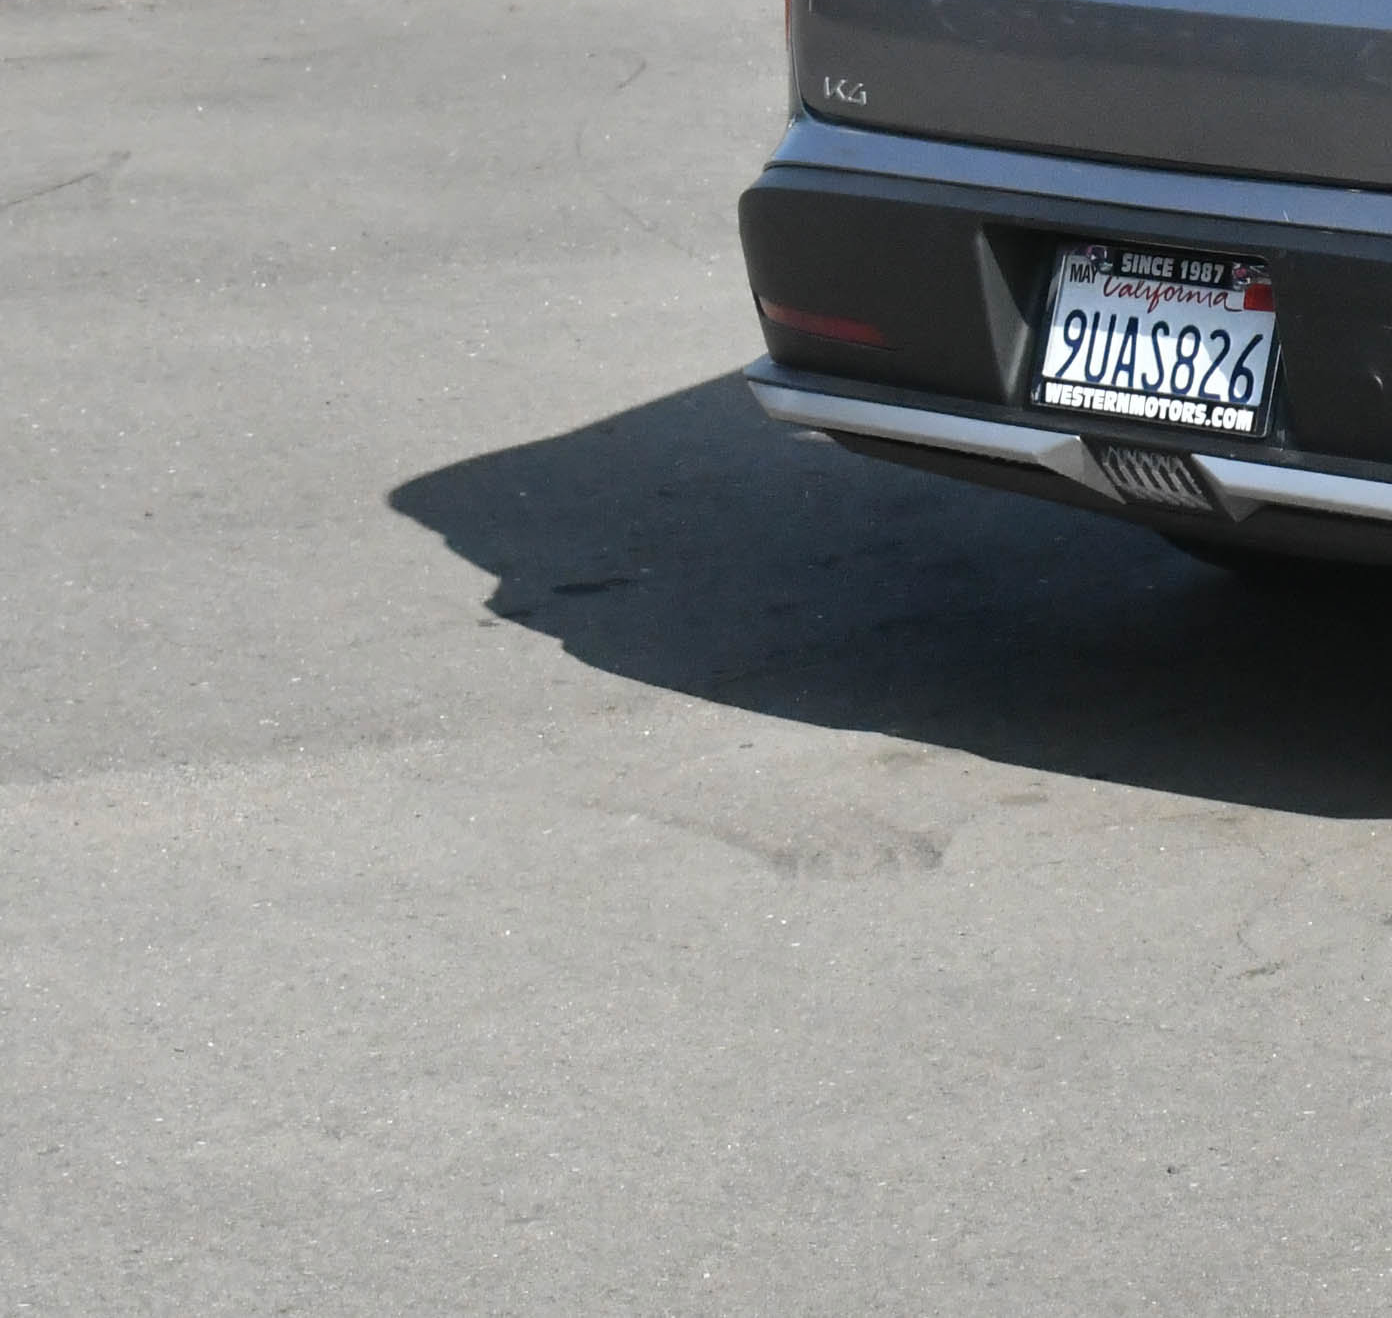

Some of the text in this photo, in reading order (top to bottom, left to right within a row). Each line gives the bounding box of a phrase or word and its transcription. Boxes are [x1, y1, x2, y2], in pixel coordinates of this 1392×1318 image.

[823, 76, 868, 107] K4
[1069, 263, 1098, 284] MAY
[1120, 253, 1225, 283] SINCE 1987
[1103, 274, 1243, 314] California
[1055, 309, 1264, 405] 9UAS826
[1044, 382, 1255, 432] WESTERNMOTORS.COM
